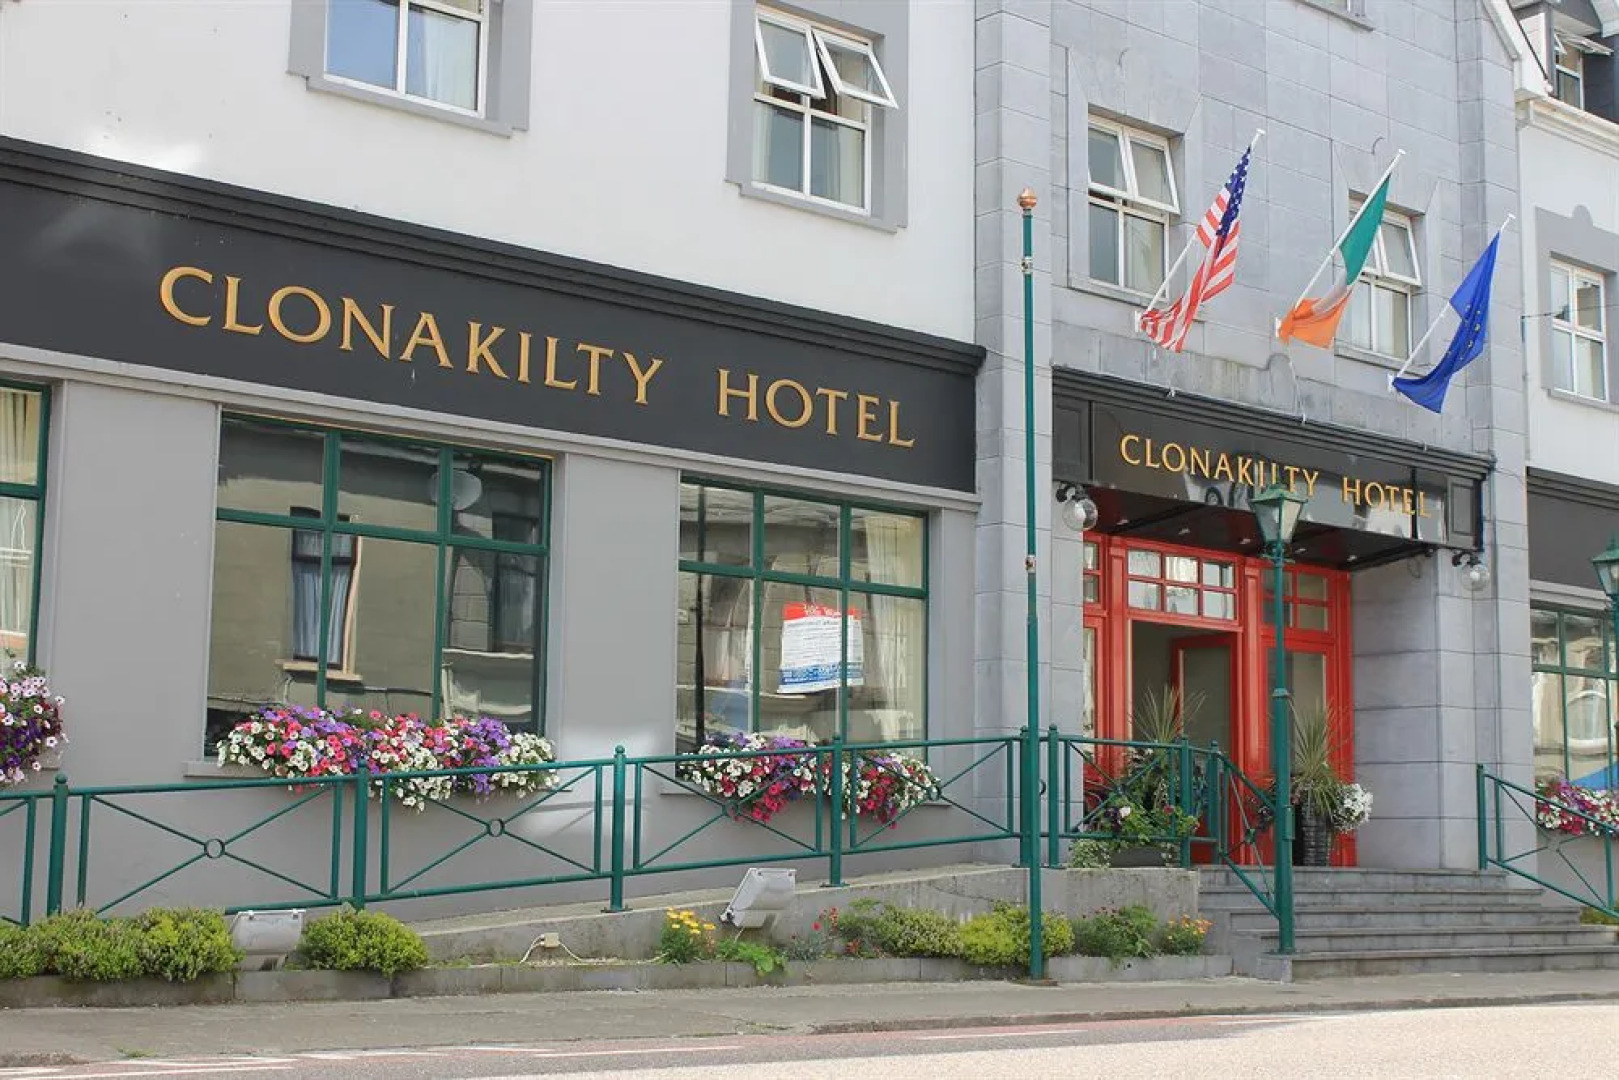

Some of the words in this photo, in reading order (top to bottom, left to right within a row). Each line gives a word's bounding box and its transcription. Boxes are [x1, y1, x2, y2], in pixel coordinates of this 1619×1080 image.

[159, 266, 663, 404] CLONAKILTY
[717, 369, 916, 448] HOTEL
[1343, 477, 1432, 517] HOTEL
